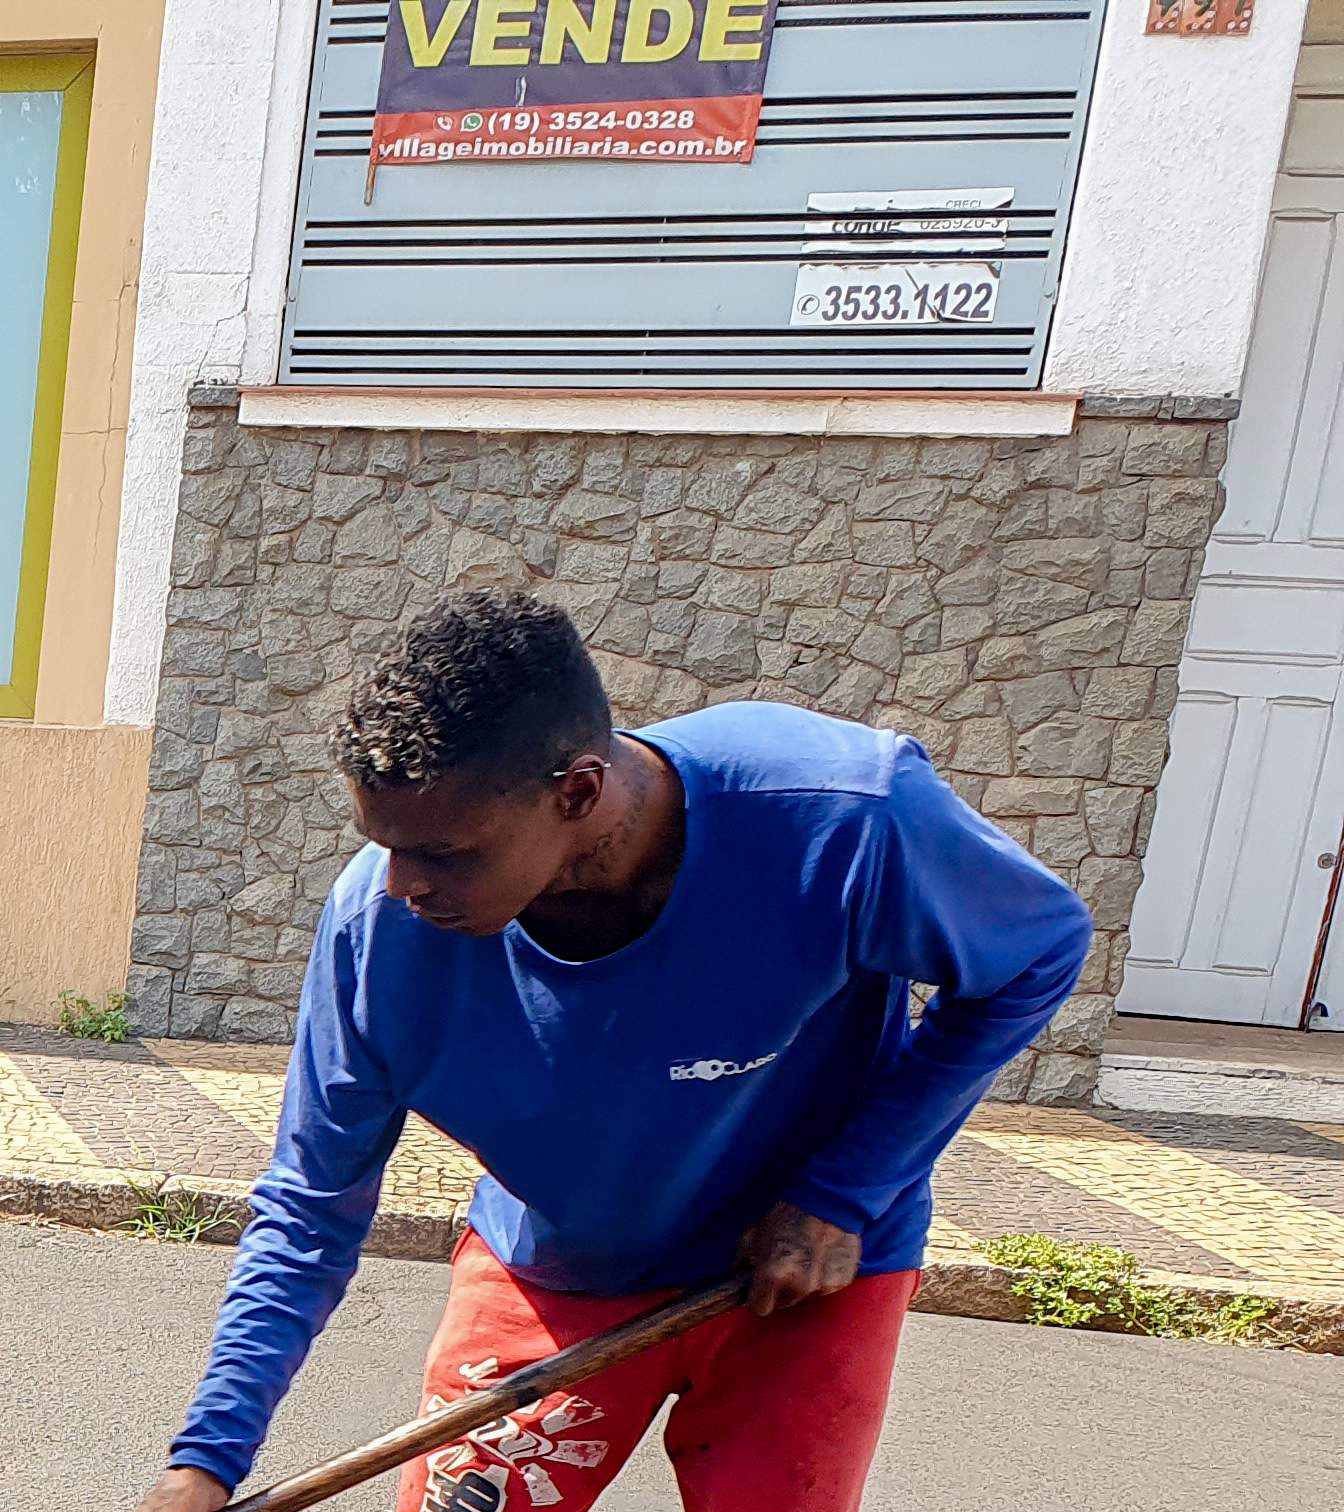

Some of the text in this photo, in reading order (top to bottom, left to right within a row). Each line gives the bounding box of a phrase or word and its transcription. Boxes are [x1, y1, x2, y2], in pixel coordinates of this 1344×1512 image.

[398, 0, 767, 67] VENDE
[488, 110, 695, 135] (19) 3524-0328
[378, 136, 748, 162] villageimobiliaria.com.br
[822, 282, 993, 322] 3533.1122
